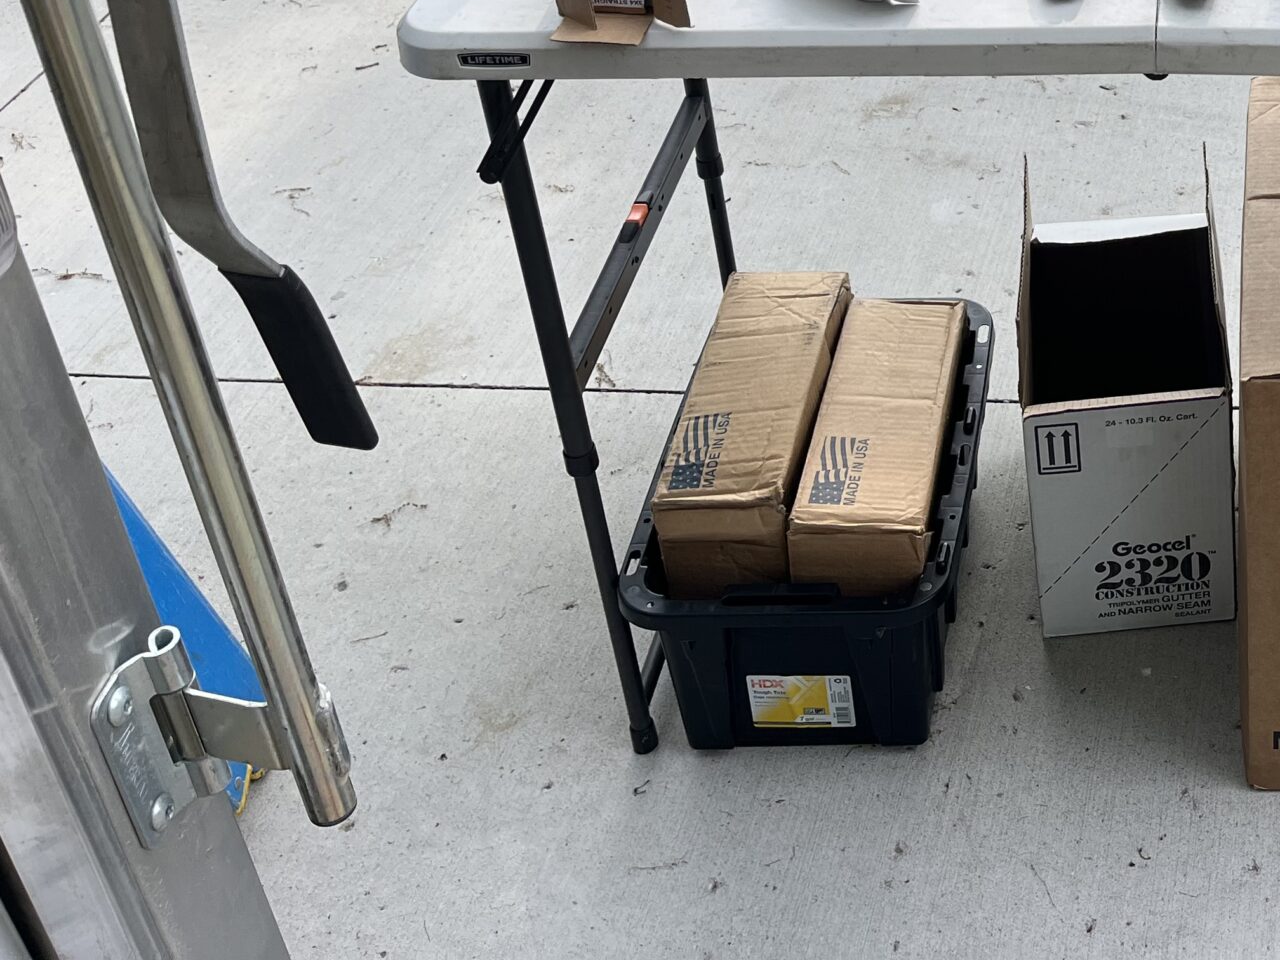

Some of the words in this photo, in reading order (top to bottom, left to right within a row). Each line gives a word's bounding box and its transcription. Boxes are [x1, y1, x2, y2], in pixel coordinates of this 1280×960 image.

[467, 56, 522, 64] LIFETIME
[715, 411, 732, 435] USA
[1125, 417, 1143, 425] 10.3
[1176, 413, 1198, 421] Cart.
[712, 438, 725, 449] IN
[854, 438, 870, 459] USA
[702, 452, 720, 488] MADE
[851, 462, 864, 472] IN
[843, 475, 861, 506] MADE
[1095, 580, 1210, 601] CONSTRUCTION
[1108, 598, 1160, 609] TRIPOLYMER
[1161, 590, 1211, 603] GUTTER
[1118, 604, 1173, 616] NARROW
[1176, 599, 1211, 610] SEAM
[1174, 608, 1212, 617] SEALANT
[751, 679, 785, 688] HDX
